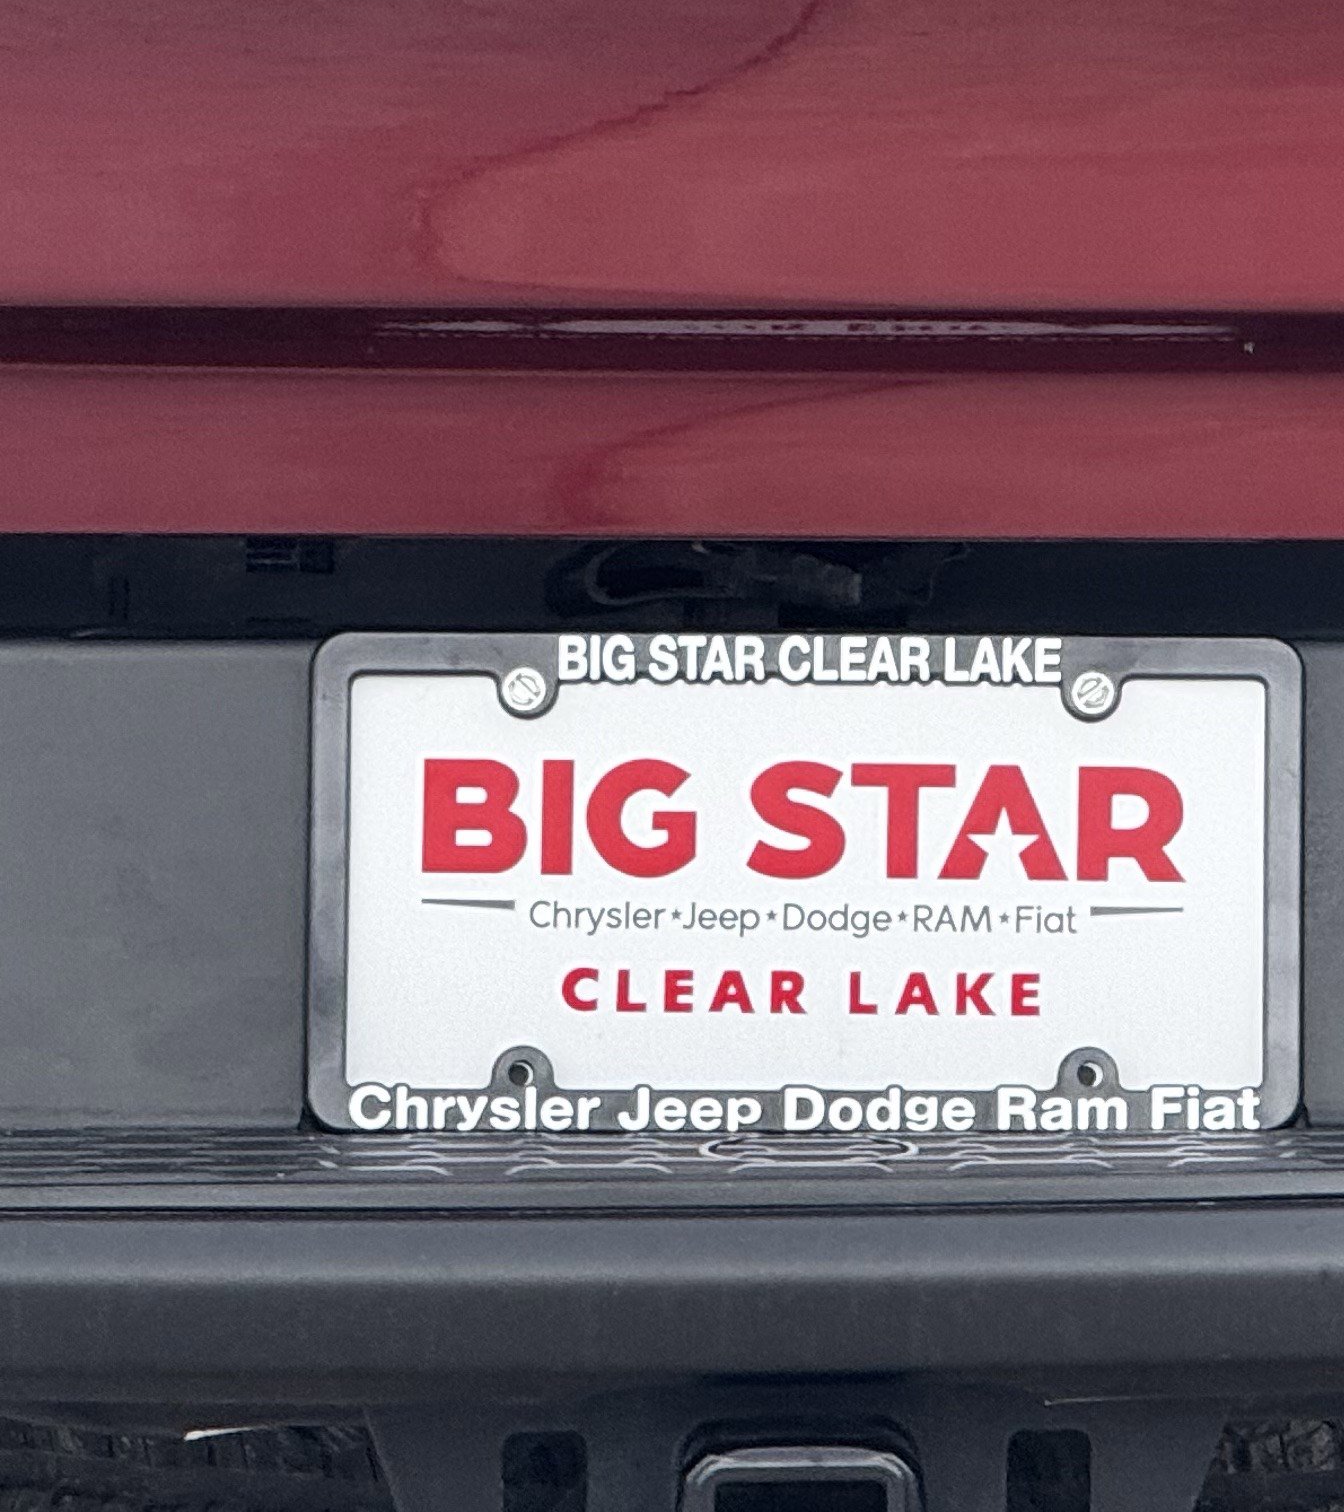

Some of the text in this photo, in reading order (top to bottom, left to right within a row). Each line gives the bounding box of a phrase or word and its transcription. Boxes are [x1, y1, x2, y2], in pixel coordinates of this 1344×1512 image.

[557, 634, 1063, 683] BIG STAR CLEAR LAKE
[421, 758, 1183, 882] BIG STAR
[529, 900, 1077, 939] Chrysler Jeep Dodge RAM Fiat
[561, 967, 1039, 1016] CLEAR LAKE
[348, 1085, 1260, 1133] Chrysler Jeep Dodge Ram Fiat
